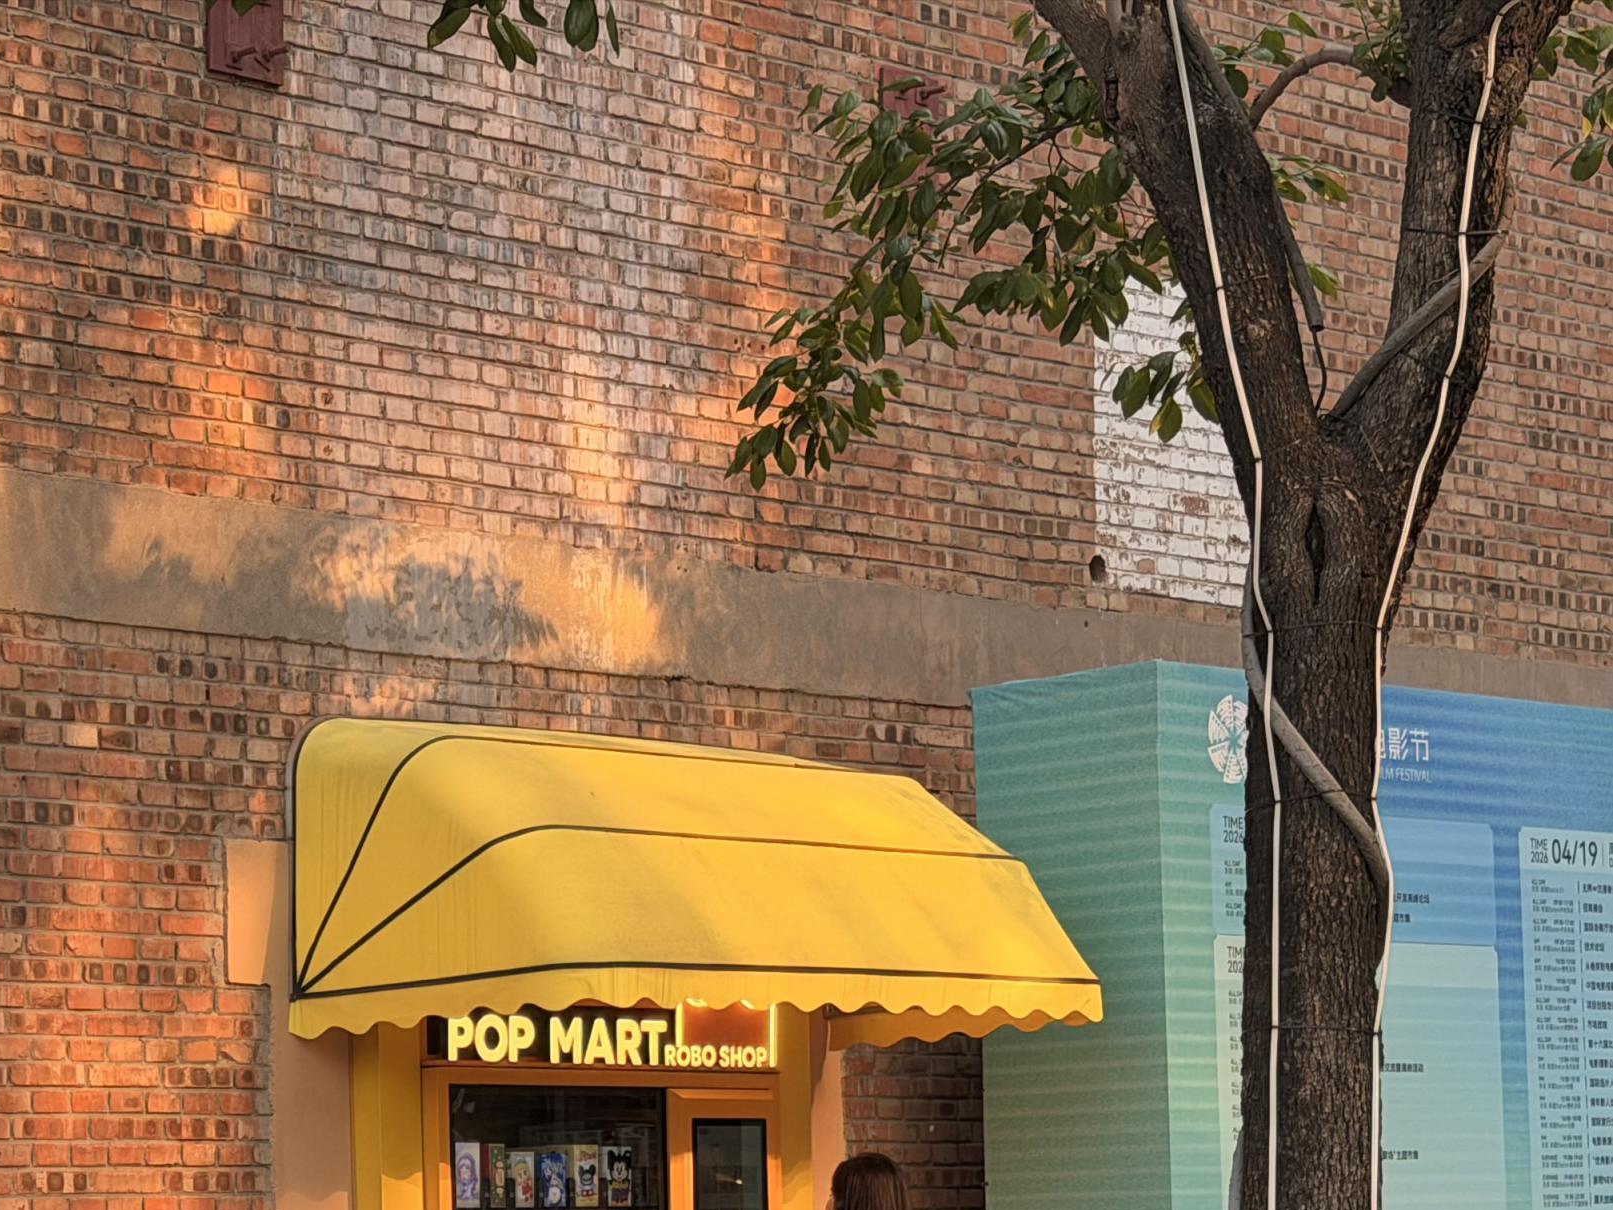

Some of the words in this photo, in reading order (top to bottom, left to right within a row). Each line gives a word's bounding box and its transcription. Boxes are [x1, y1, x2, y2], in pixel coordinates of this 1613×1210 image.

[1396, 767, 1432, 783] FESTIVAL
[1222, 815, 1244, 830] TIME
[1223, 830, 1245, 844] 2026
[1529, 837, 1548, 851] TIME
[1530, 850, 1549, 864] 2026
[1551, 838, 1598, 867] 04/19
[1226, 945, 1243, 959] TIM
[1227, 960, 1243, 973] 202
[447, 1013, 535, 1063] POP
[548, 1016, 668, 1067] MART
[663, 1043, 717, 1068] ROBO
[718, 1044, 768, 1069] SHOP
